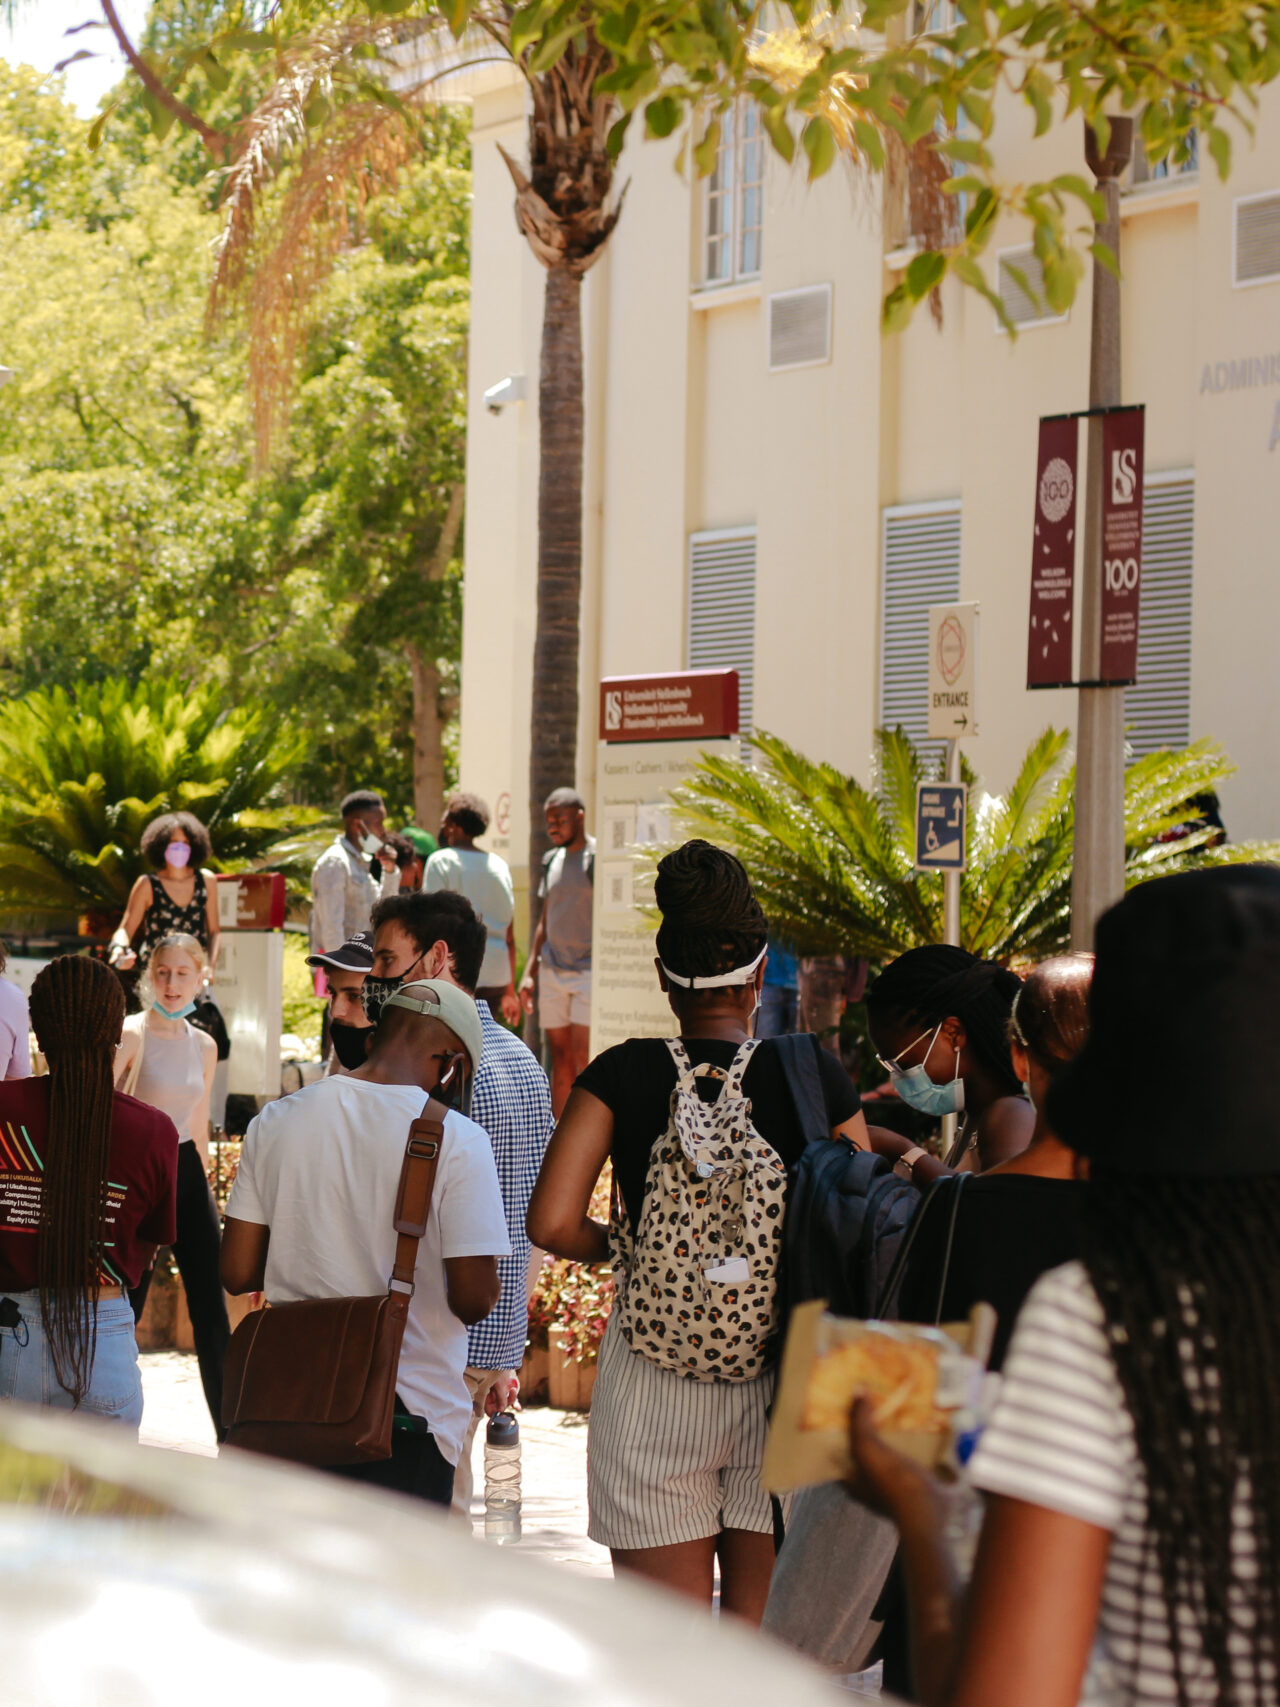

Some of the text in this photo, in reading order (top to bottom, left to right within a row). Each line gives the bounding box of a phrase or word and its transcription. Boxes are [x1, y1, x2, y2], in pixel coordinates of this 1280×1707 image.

[1044, 480, 1070, 501] 100
[1104, 558, 1139, 591] 100
[933, 691, 968, 709] ENTRANCE
[4, 1191, 37, 1200] Compassion
[106, 1191, 126, 1200] ARDES
[10, 1208, 33, 1216] Respect
[6, 1216, 25, 1225] Equity
